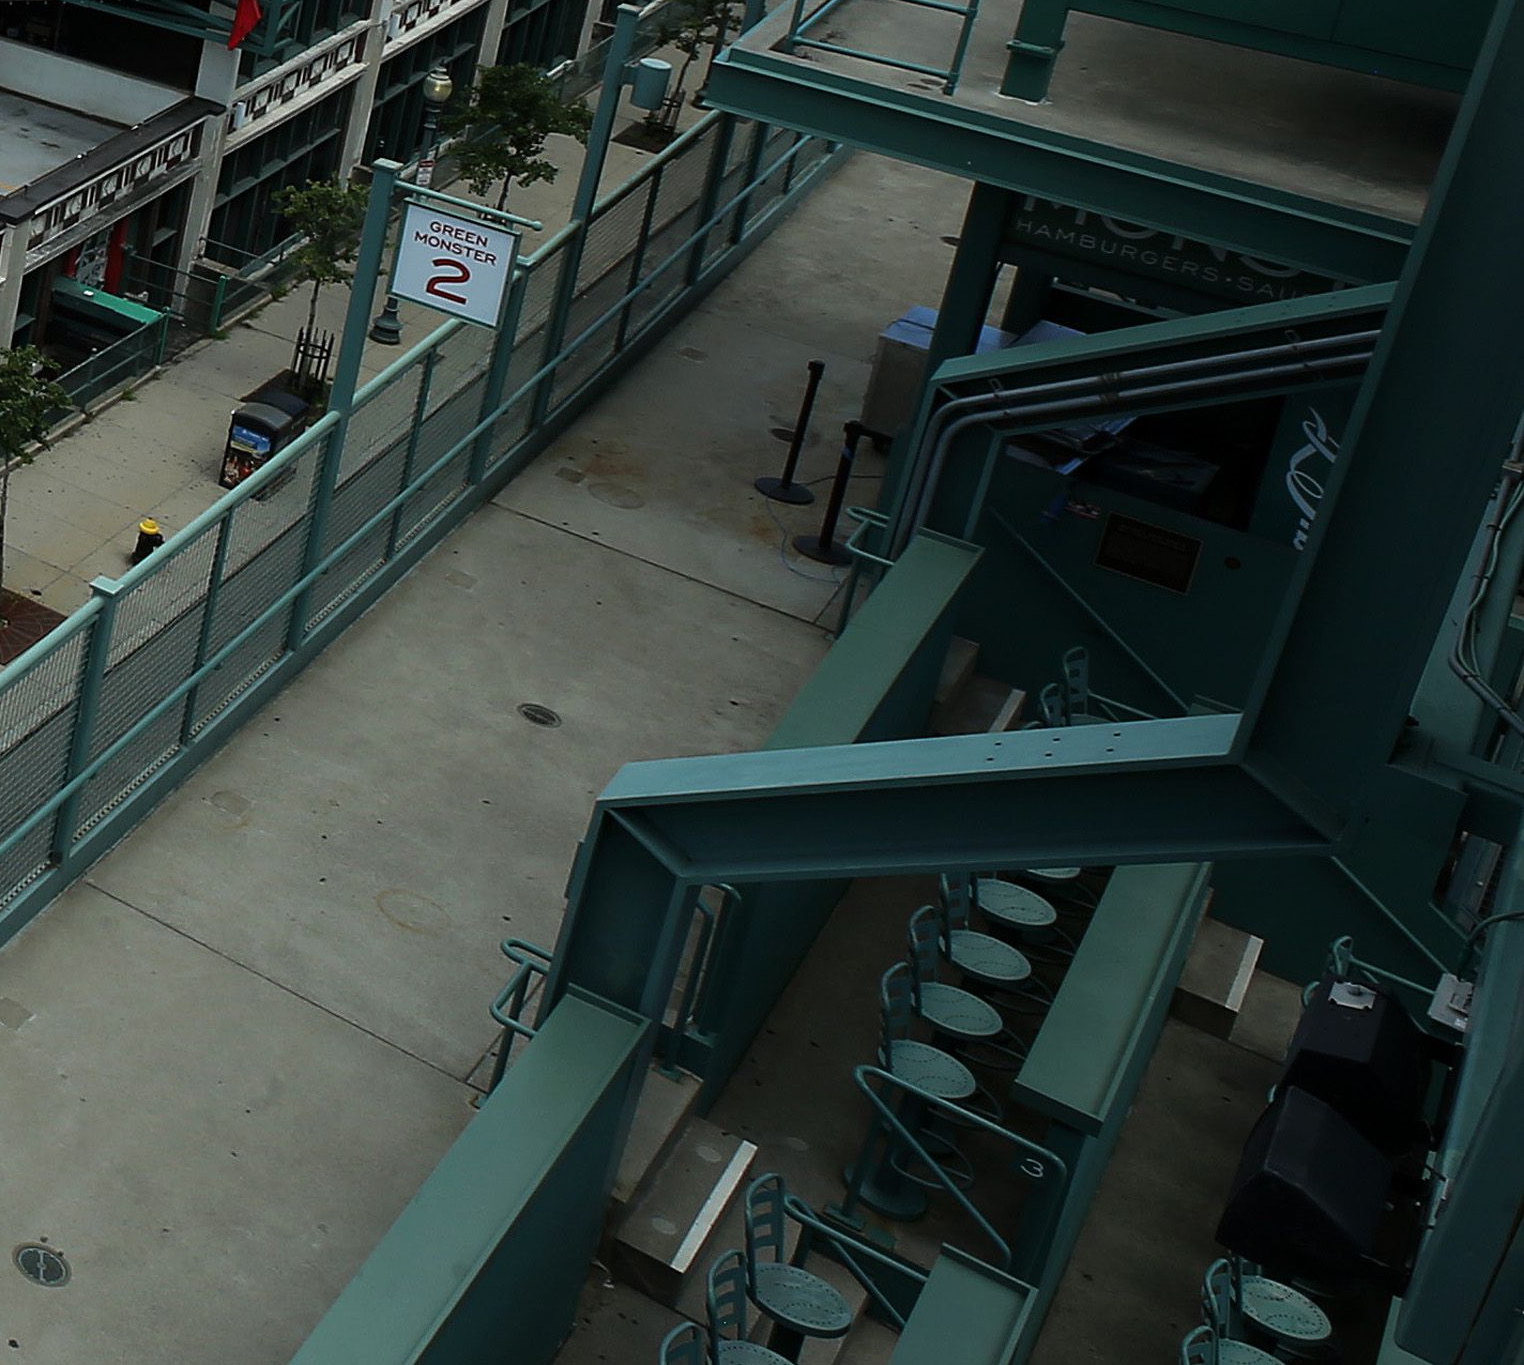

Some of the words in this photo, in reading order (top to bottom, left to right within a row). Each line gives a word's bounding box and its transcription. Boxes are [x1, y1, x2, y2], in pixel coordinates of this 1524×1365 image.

[414, 230, 498, 267] MONSTER
[429, 220, 489, 248] GREEN
[1015, 217, 1221, 283] HAMBURGERS
[425, 258, 471, 306] 2
[1019, 1157, 1044, 1178] 3
